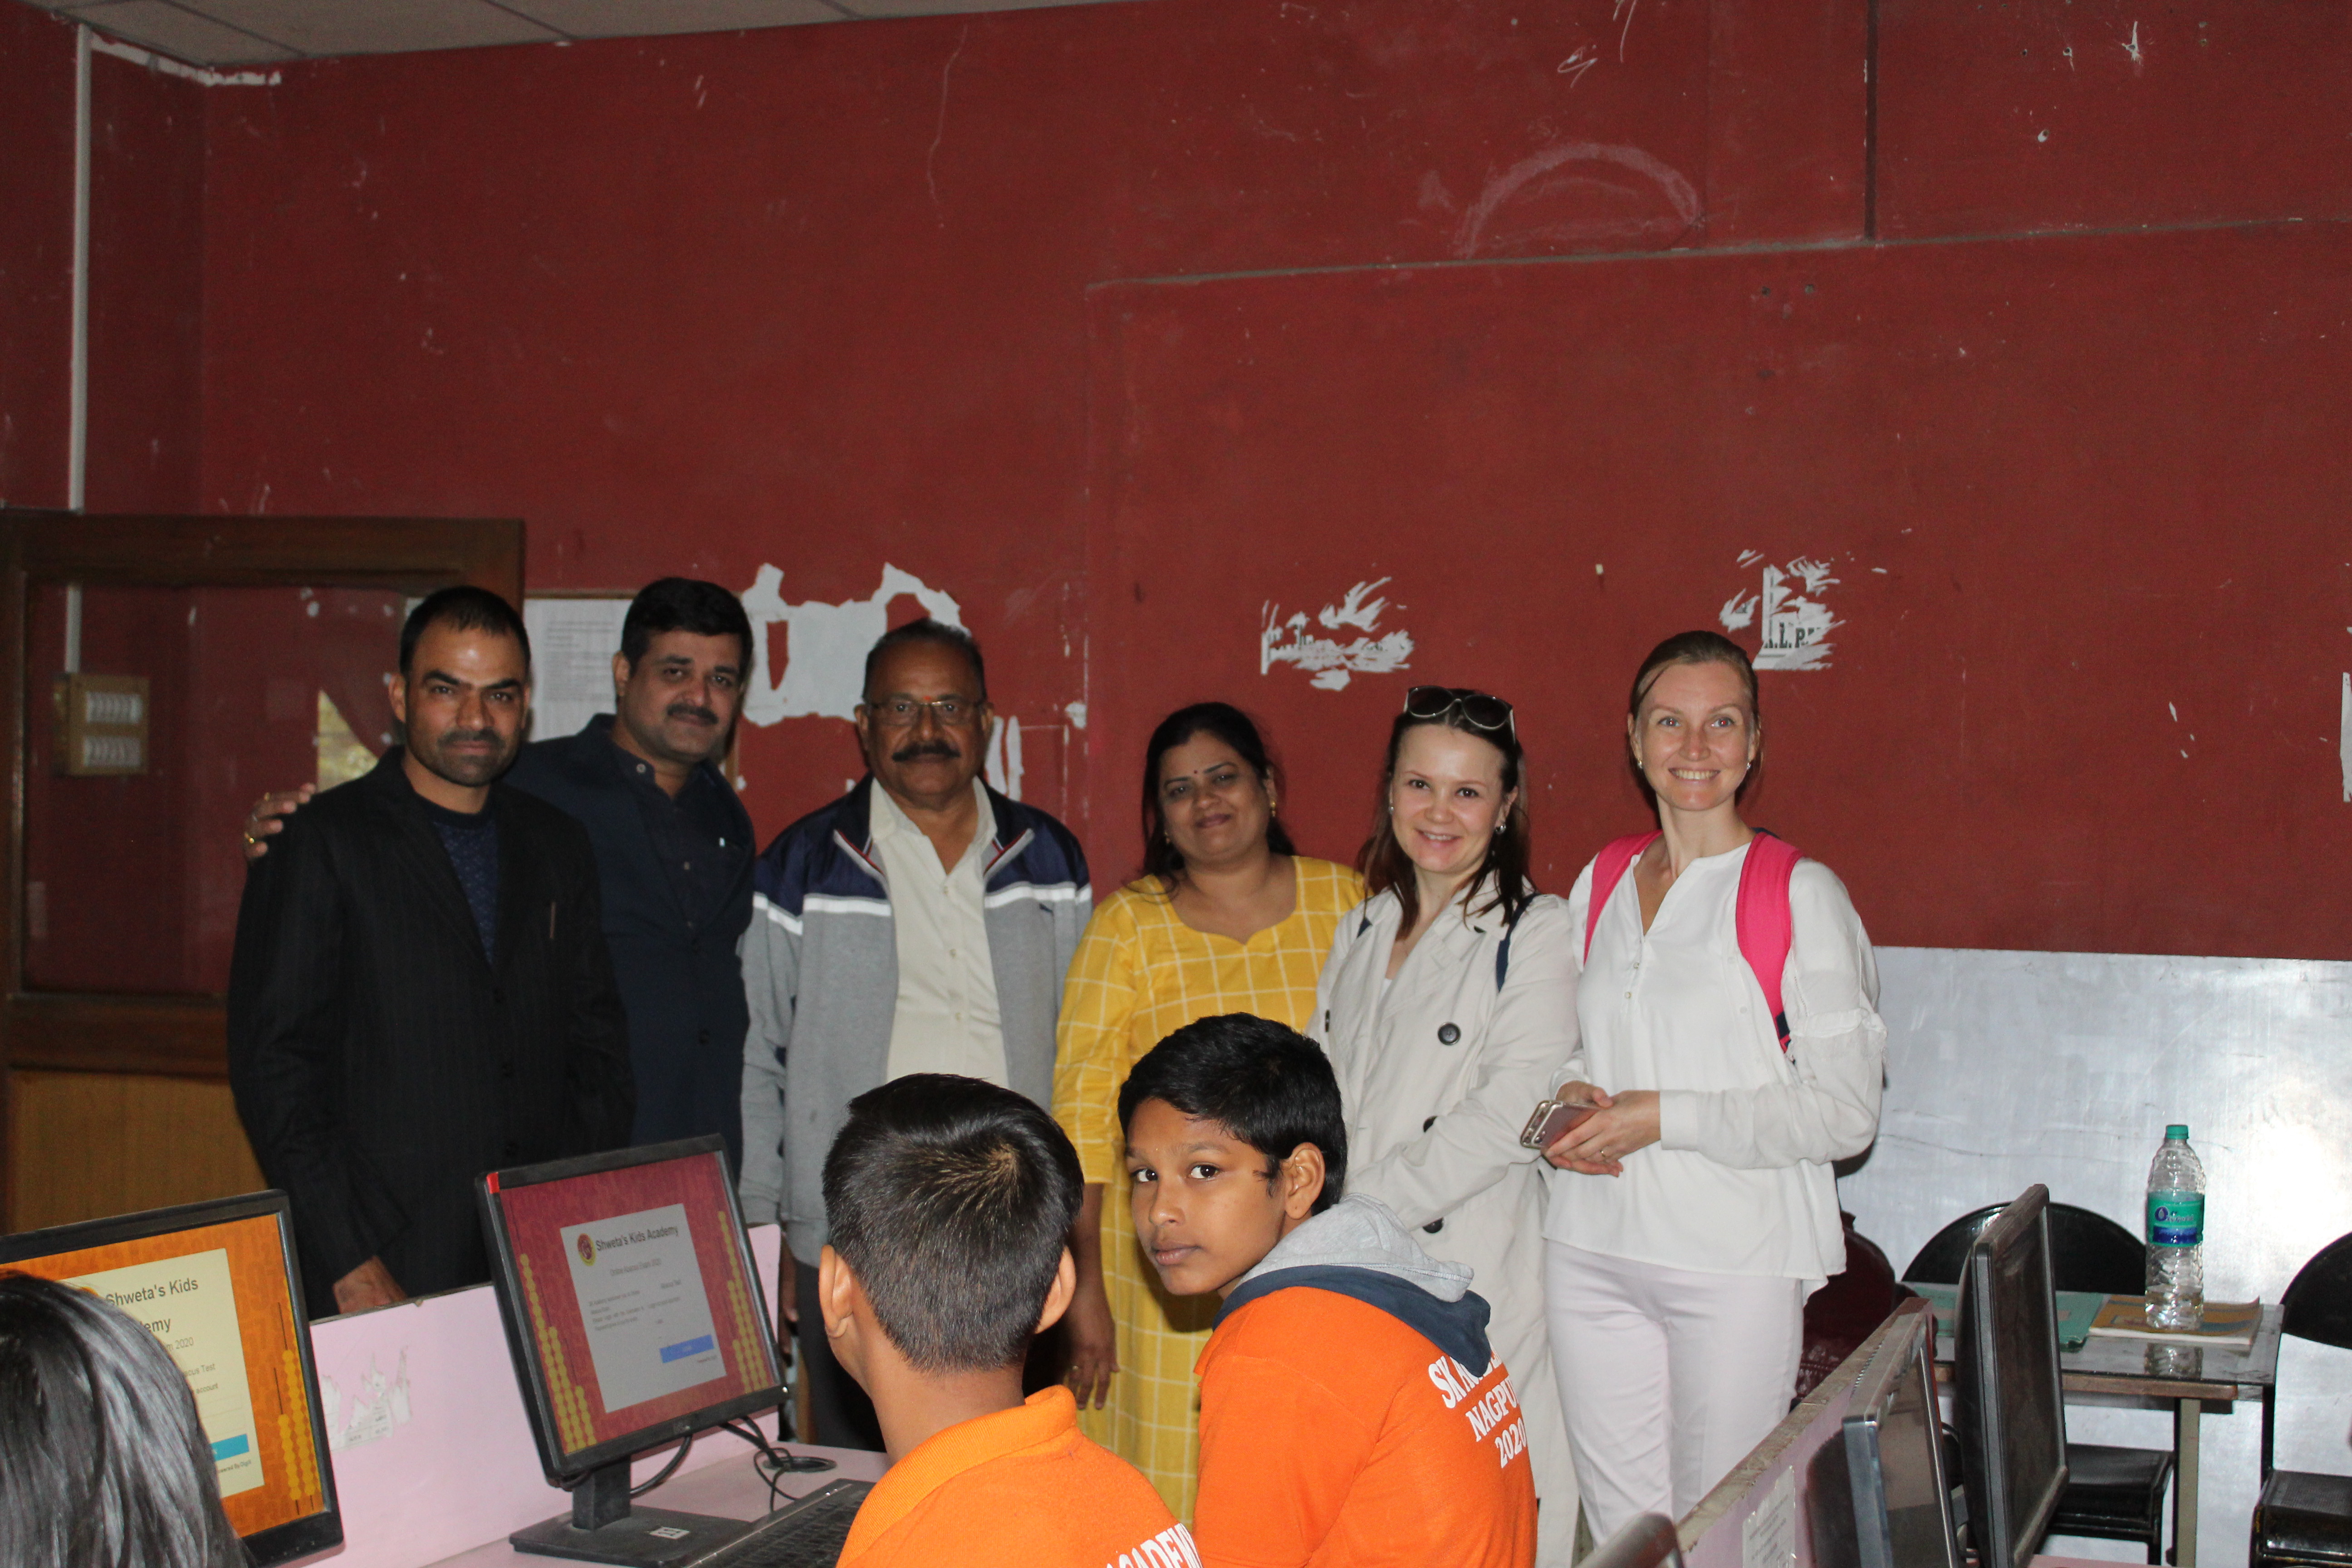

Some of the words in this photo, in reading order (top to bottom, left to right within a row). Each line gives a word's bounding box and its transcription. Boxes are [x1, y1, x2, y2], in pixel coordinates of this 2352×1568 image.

[595, 1235, 628, 1251] Shweta's
[628, 1231, 646, 1244] Kids
[647, 1226, 679, 1240] Academy
[105, 1284, 166, 1306] Shweta's
[169, 1277, 199, 1295] Kids
[140, 1318, 171, 1333] emy
[175, 1337, 194, 1349] 2020
[201, 1363, 216, 1373] Test
[196, 1382, 219, 1394] account
[1428, 1356, 1468, 1408] SK
[1465, 1375, 1519, 1442] NAGPU
[1494, 1417, 1527, 1469] 2020
